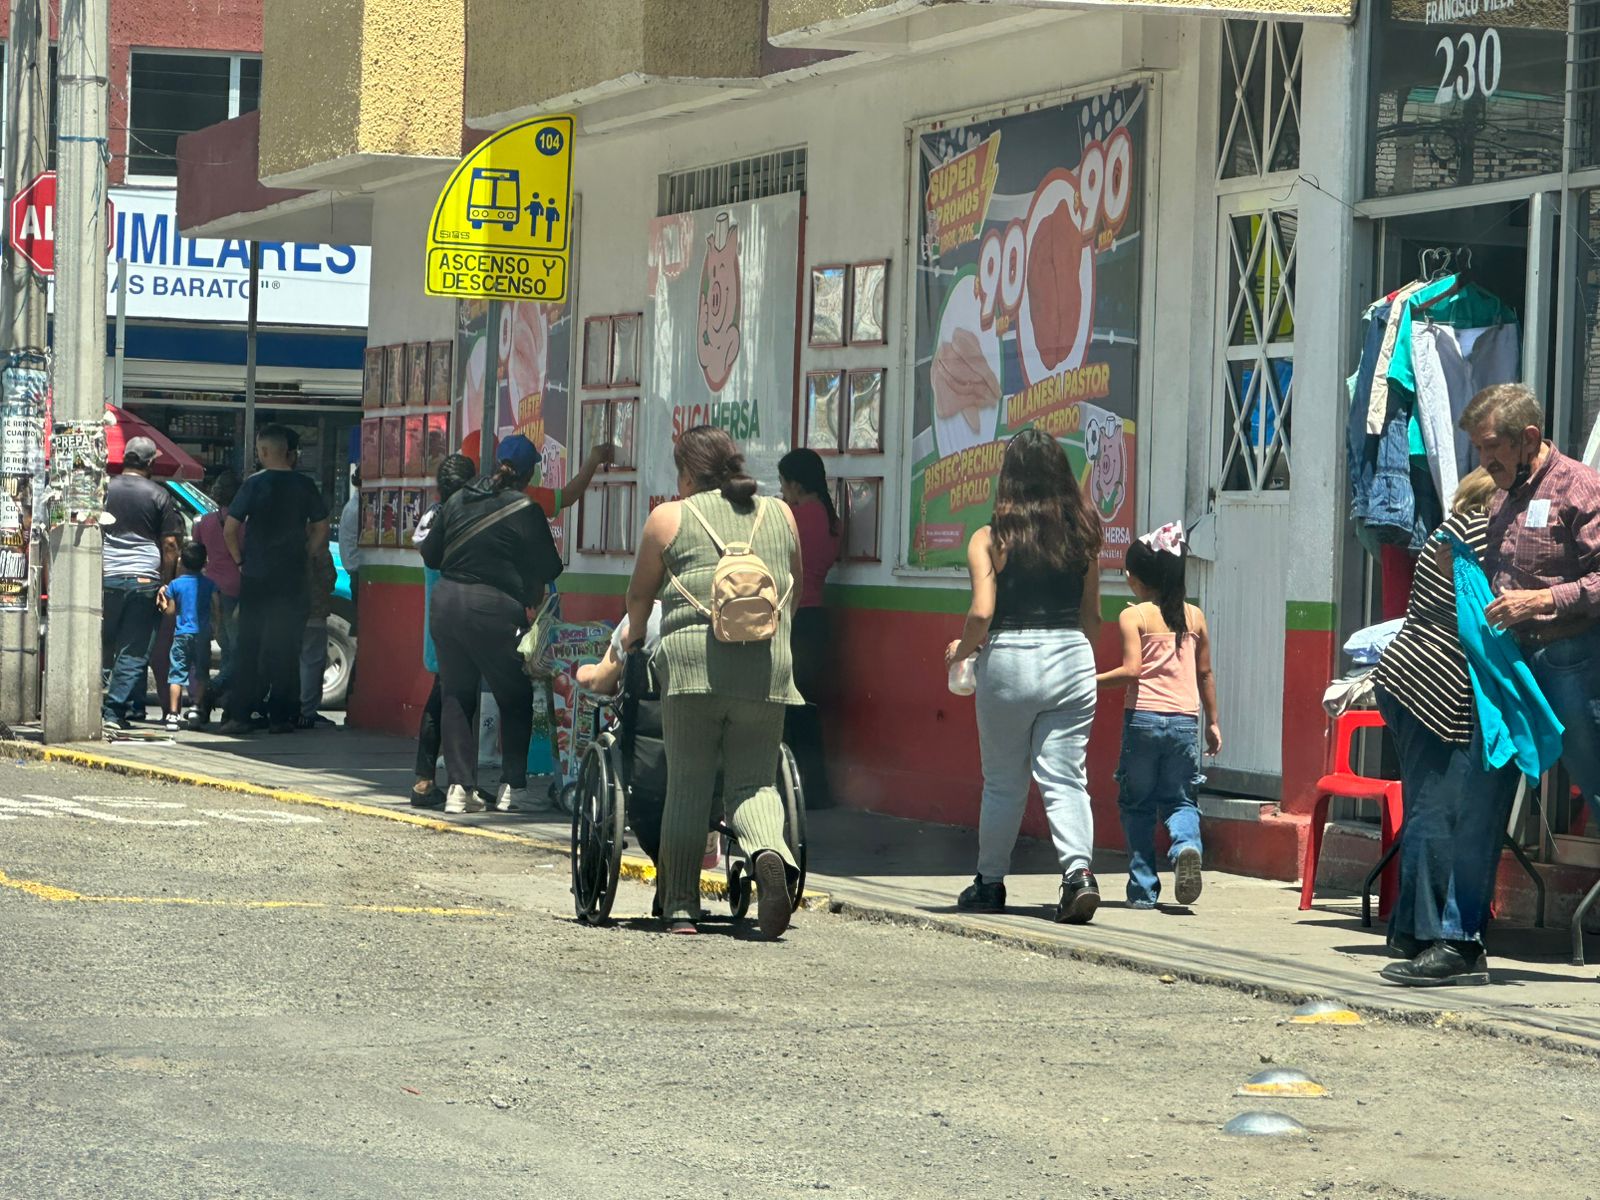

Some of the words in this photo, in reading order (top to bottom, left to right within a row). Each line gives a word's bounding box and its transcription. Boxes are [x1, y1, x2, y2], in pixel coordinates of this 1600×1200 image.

[1434, 27, 1502, 105] 230
[539, 133, 560, 150] 104
[930, 153, 977, 206] SUPER
[19, 205, 54, 241] AL
[936, 187, 980, 227] PROMOS
[116, 211, 356, 275] IMILARES
[439, 253, 530, 276] ASCENSO
[542, 258, 556, 277] Y
[442, 271, 547, 296] DESCENSO
[1007, 373, 1063, 424] MILANESA
[1063, 364, 1111, 400] PASTOR
[1046, 404, 1080, 436] CERDO
[55, 435, 90, 450] PREPA
[924, 453, 960, 496] BISTEC
[960, 442, 1005, 478] PECHUG
[963, 477, 991, 505] POLLO
